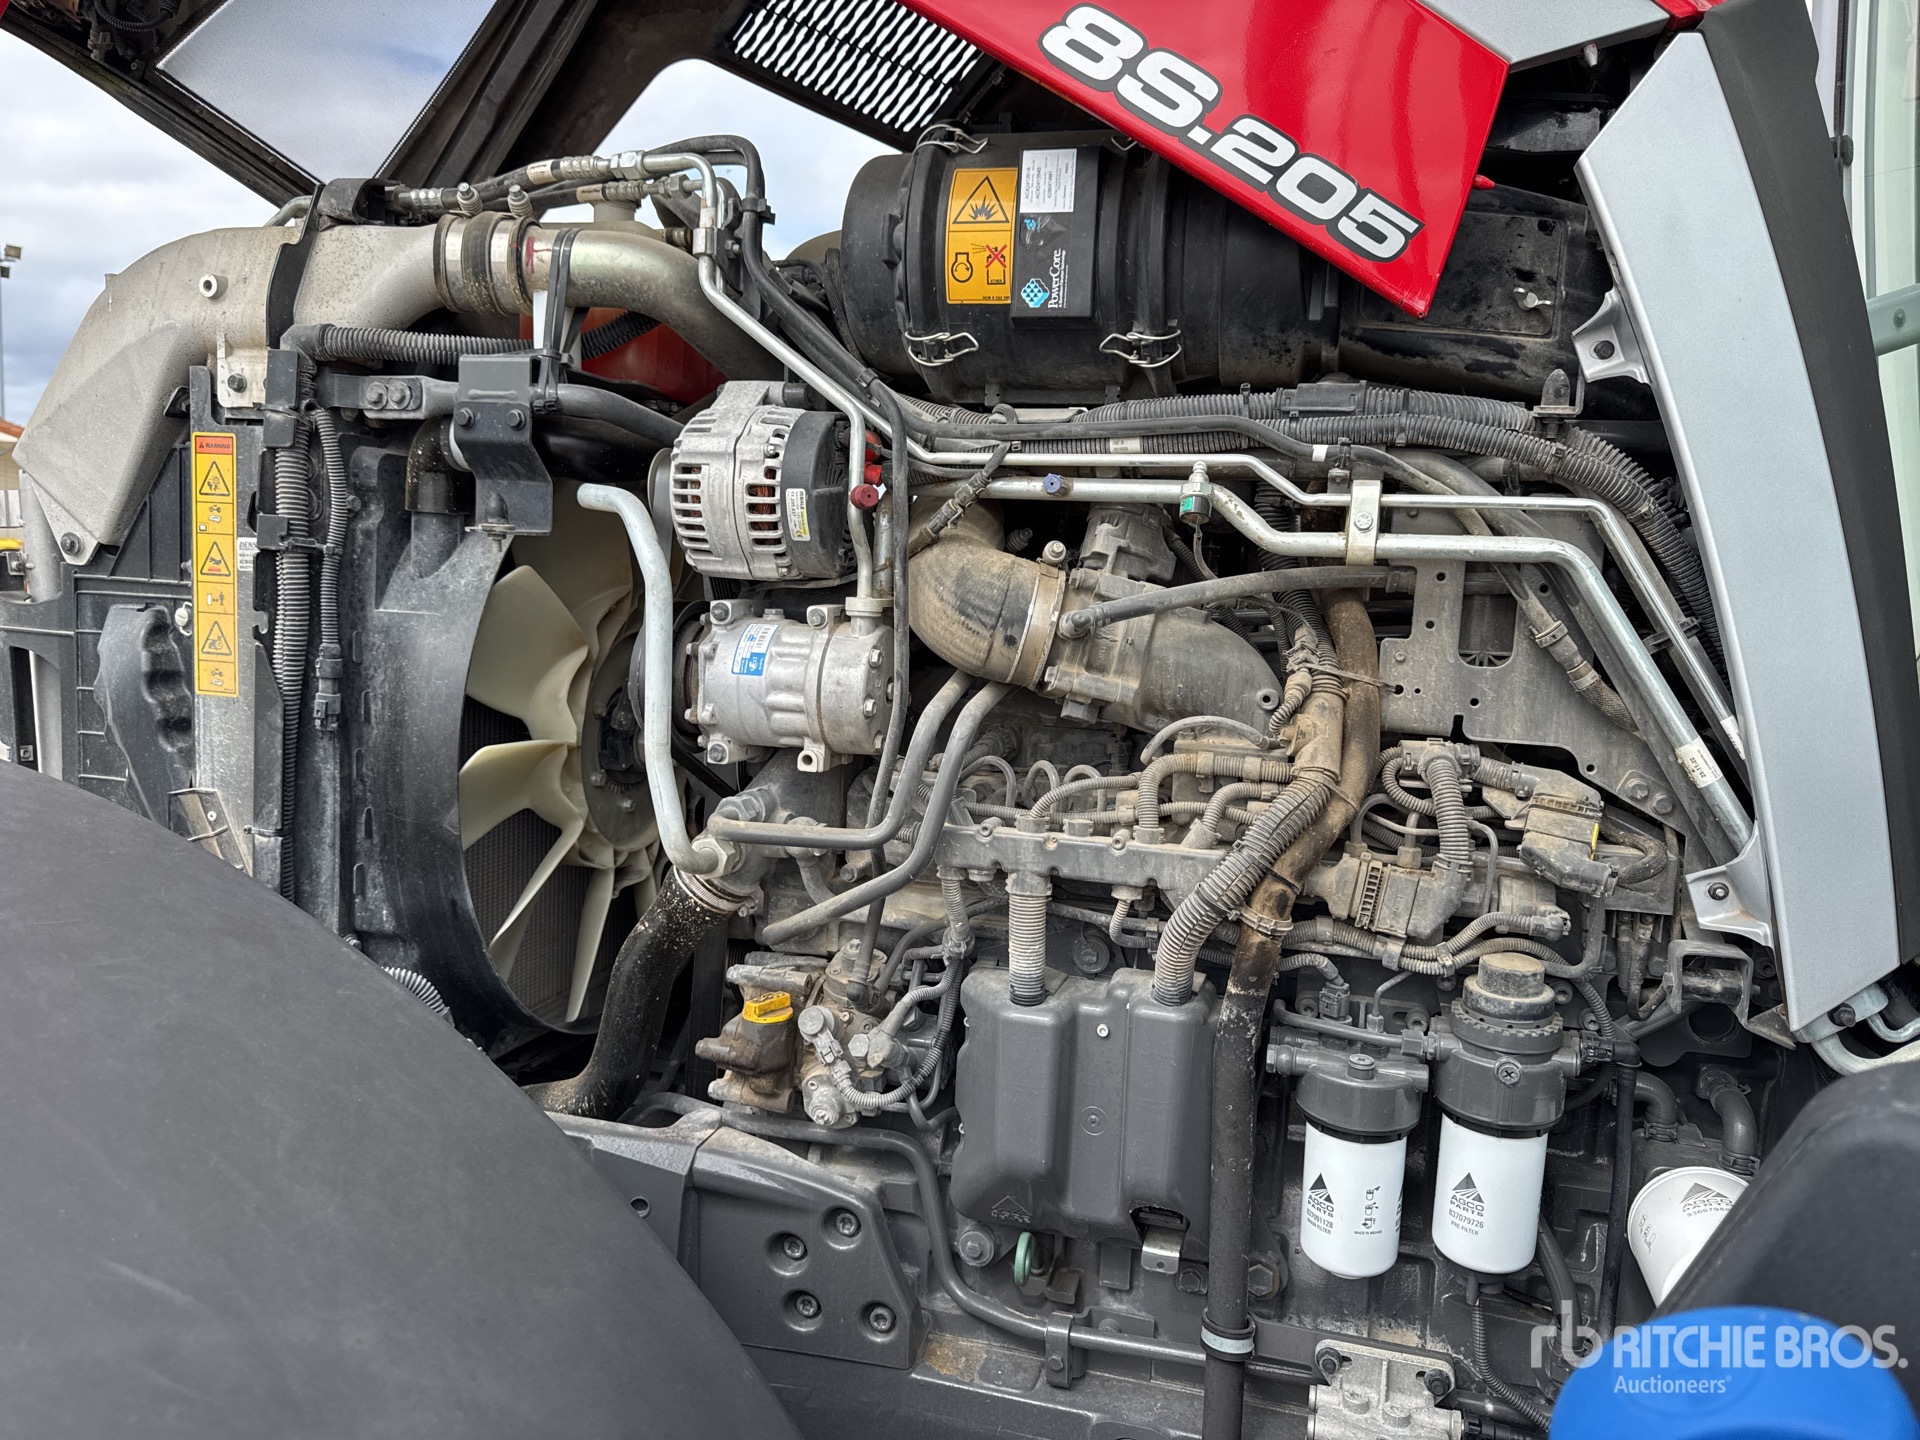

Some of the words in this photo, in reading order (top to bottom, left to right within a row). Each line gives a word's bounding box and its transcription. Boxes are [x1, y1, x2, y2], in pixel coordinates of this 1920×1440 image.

[1040, 4, 1423, 261] 8S.205
[1048, 249, 1061, 308] PowerCore
[1308, 1200, 1333, 1218] PARTS
[1309, 1195, 1334, 1212] AGCO
[1450, 1200, 1483, 1217] PARTS
[1451, 1195, 1484, 1212] AGCO
[1682, 1199, 1732, 1209] AGCO
[1449, 1209, 1484, 1229] 837079726
[1317, 1224, 1331, 1235] FILTER
[1451, 1220, 1479, 1236] PRE-FILTER
